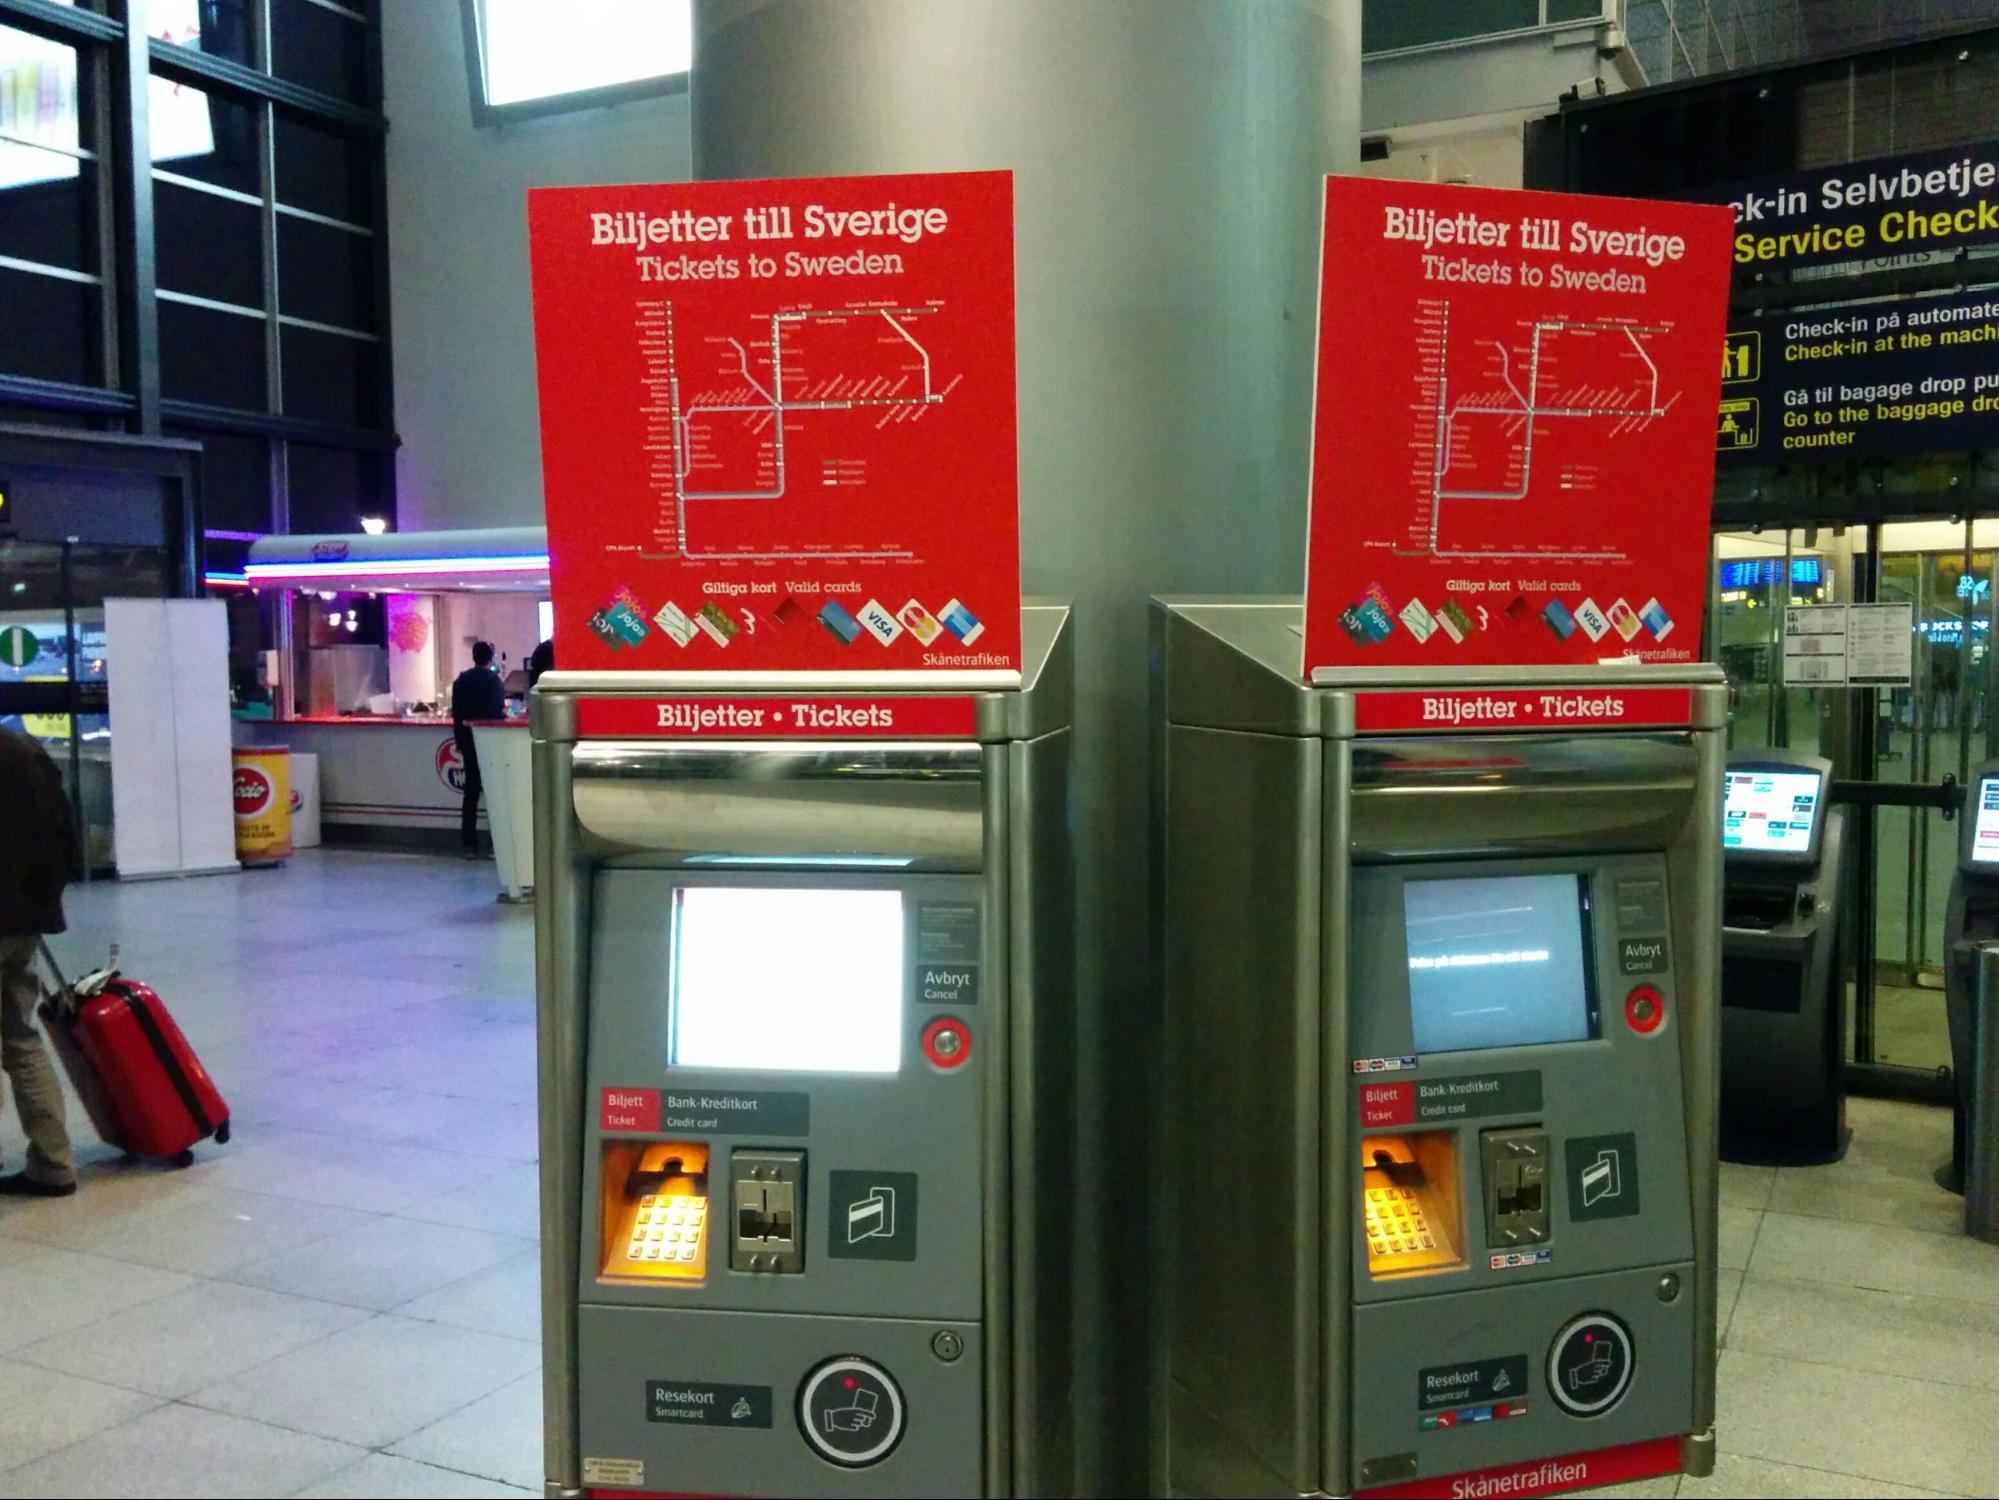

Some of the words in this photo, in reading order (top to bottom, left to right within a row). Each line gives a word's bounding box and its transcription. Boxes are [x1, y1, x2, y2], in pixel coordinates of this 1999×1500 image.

[1821, 159, 1999, 210] Selvbetje
[591, 210, 732, 252] Biljetter
[743, 207, 794, 239] till
[804, 202, 949, 244] Sverige
[1384, 206, 1510, 251] Biljetter
[1521, 217, 1560, 252] till
[1570, 222, 1686, 267] Sverige
[1734, 223, 1866, 264] Service
[1880, 200, 1999, 244] Check
[636, 253, 740, 283] Tickets
[749, 255, 777, 278] to
[785, 250, 904, 278] Sweden
[1421, 255, 1512, 286] Tickets
[1520, 262, 1544, 287] to
[1550, 264, 1647, 294] Sweden
[1785, 315, 1869, 340] Check-in
[1876, 312, 1901, 333] på
[1907, 301, 1999, 327] automate
[1785, 336, 1868, 361] Check-in
[1874, 335, 1894, 353] at
[1900, 328, 1932, 349] the
[1783, 386, 1809, 406] Gå
[1815, 383, 1833, 403] til
[1840, 377, 1913, 406] bagage
[1920, 373, 1966, 398] drop
[1783, 411, 1808, 428] Go
[1814, 409, 1832, 425] to
[1838, 405, 1870, 424] the
[1877, 396, 1964, 423] baggage
[1783, 430, 1856, 450] counter
[702, 581, 748, 596] Giltiga
[750, 581, 777, 594] kort
[785, 581, 820, 594] Valid
[824, 581, 862, 594] cards
[1446, 579, 1486, 594] Giltiga
[1488, 579, 1511, 591] kort
[1518, 580, 1547, 591] Valid
[1550, 580, 1582, 592] cards
[868, 610, 894, 638] VISA
[1583, 608, 1603, 635] VISA
[923, 652, 1010, 667] Skånetrafiken
[657, 704, 764, 731] Biljetter
[792, 704, 893, 728] Tickets
[1422, 697, 1517, 724] Biljetter
[1540, 695, 1624, 718] Tickets
[1625, 943, 1662, 960] Avbryt
[1626, 960, 1653, 971] Cancel
[924, 970, 970, 989] Avbryt
[924, 989, 958, 1000] Cancel
[608, 1094, 643, 1108] Biljett
[668, 1096, 758, 1110] Bank-Kreditkort
[1366, 1089, 1398, 1103] Biljett
[1367, 1110, 1393, 1121] Ticket
[1420, 1105, 1446, 1116] Credit
[1448, 1103, 1466, 1114] card
[608, 1115, 635, 1126] Ticket
[667, 1116, 695, 1128] Credit
[697, 1117, 718, 1128] card
[1426, 1370, 1480, 1389] Resekort
[655, 1387, 715, 1405] Resekort
[1426, 1389, 1470, 1403] Smartcard
[655, 1407, 704, 1419] Smartcard
[1451, 1460, 1588, 1499] Skånetrafiken
